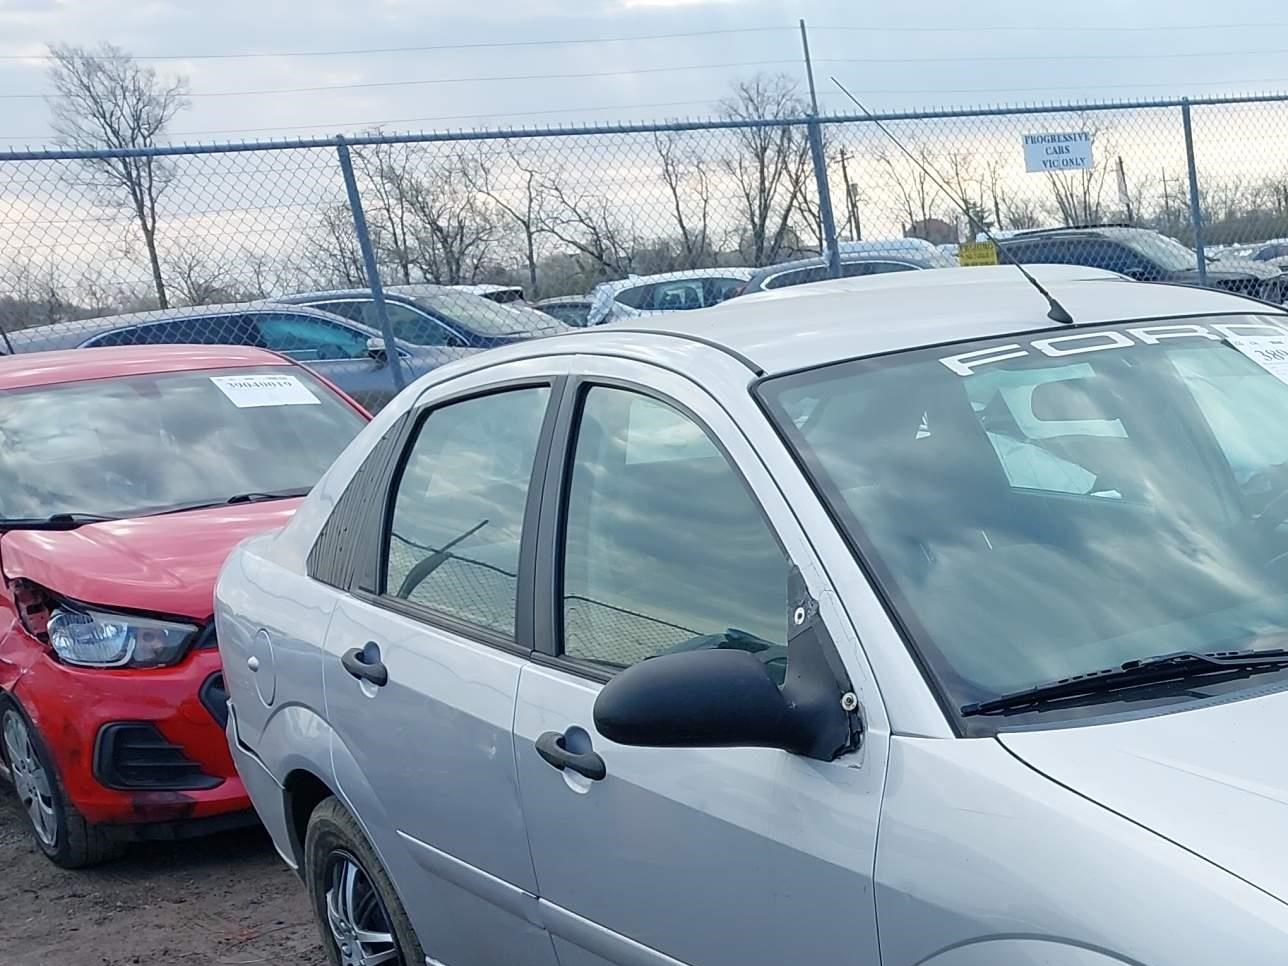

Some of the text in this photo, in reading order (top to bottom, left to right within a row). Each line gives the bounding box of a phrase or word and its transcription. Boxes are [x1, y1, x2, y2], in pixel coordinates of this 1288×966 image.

[1024, 132, 1090, 145] PROGRESSIVE
[1045, 145, 1071, 155] CARS
[1042, 157, 1086, 168] VIC ONLY
